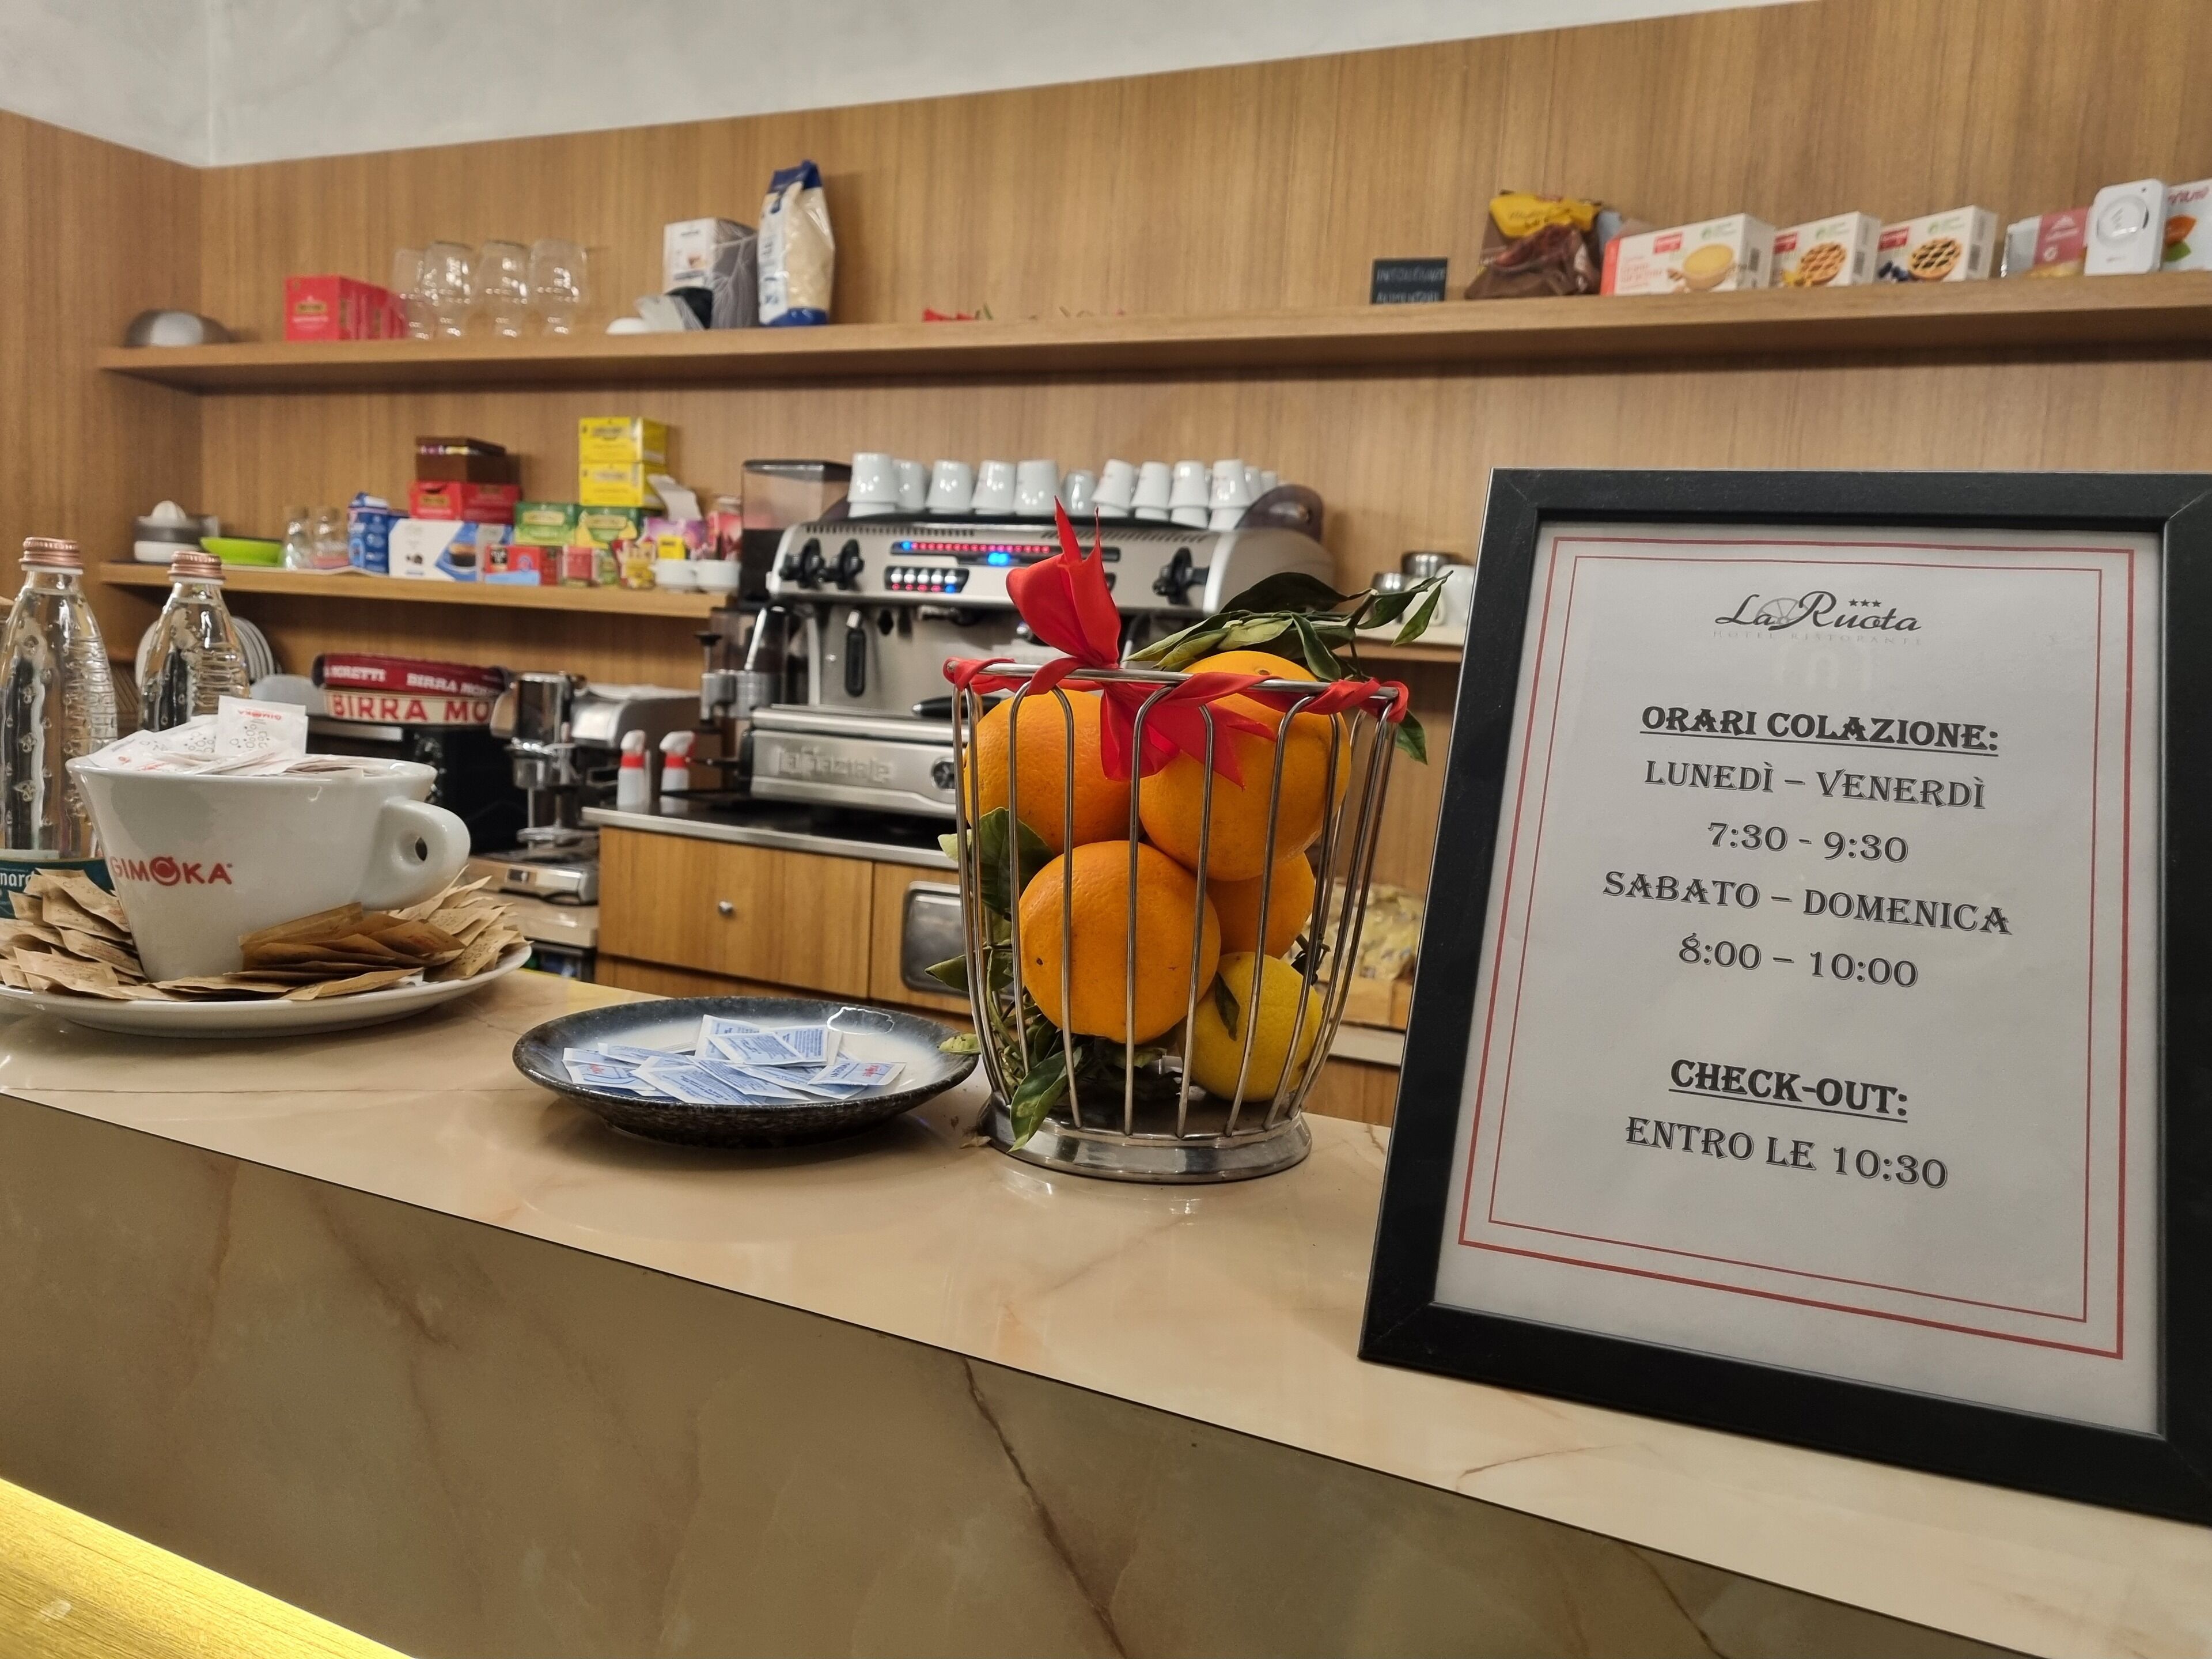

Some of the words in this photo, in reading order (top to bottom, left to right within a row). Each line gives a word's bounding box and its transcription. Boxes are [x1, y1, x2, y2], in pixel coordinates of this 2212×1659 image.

[1715, 593, 1775, 626] La
[1768, 590, 1922, 631] Ruota
[332, 694, 427, 721] BIRRA
[1641, 706, 1757, 736] ORARI
[1767, 712, 1999, 752] COLAZIONE:
[1644, 760, 1774, 794] LUNEDÌ
[1815, 768, 1986, 810] VENERDÌ
[1707, 822, 1789, 853] 7:30
[1824, 831, 1909, 864] 9:30
[109, 856, 233, 887] GIMOKA
[1602, 871, 1761, 910] SABATO
[1802, 889, 2013, 936] DOMENICA
[1679, 932, 1762, 971] 8:00
[1809, 951, 1919, 988] 10:00
[1671, 1059, 1908, 1117] CHECK-OUT:
[1625, 1116, 1755, 1161] ENTRO
[1766, 1136, 1817, 1172] LE
[1833, 1146, 1949, 1190] 10:30
